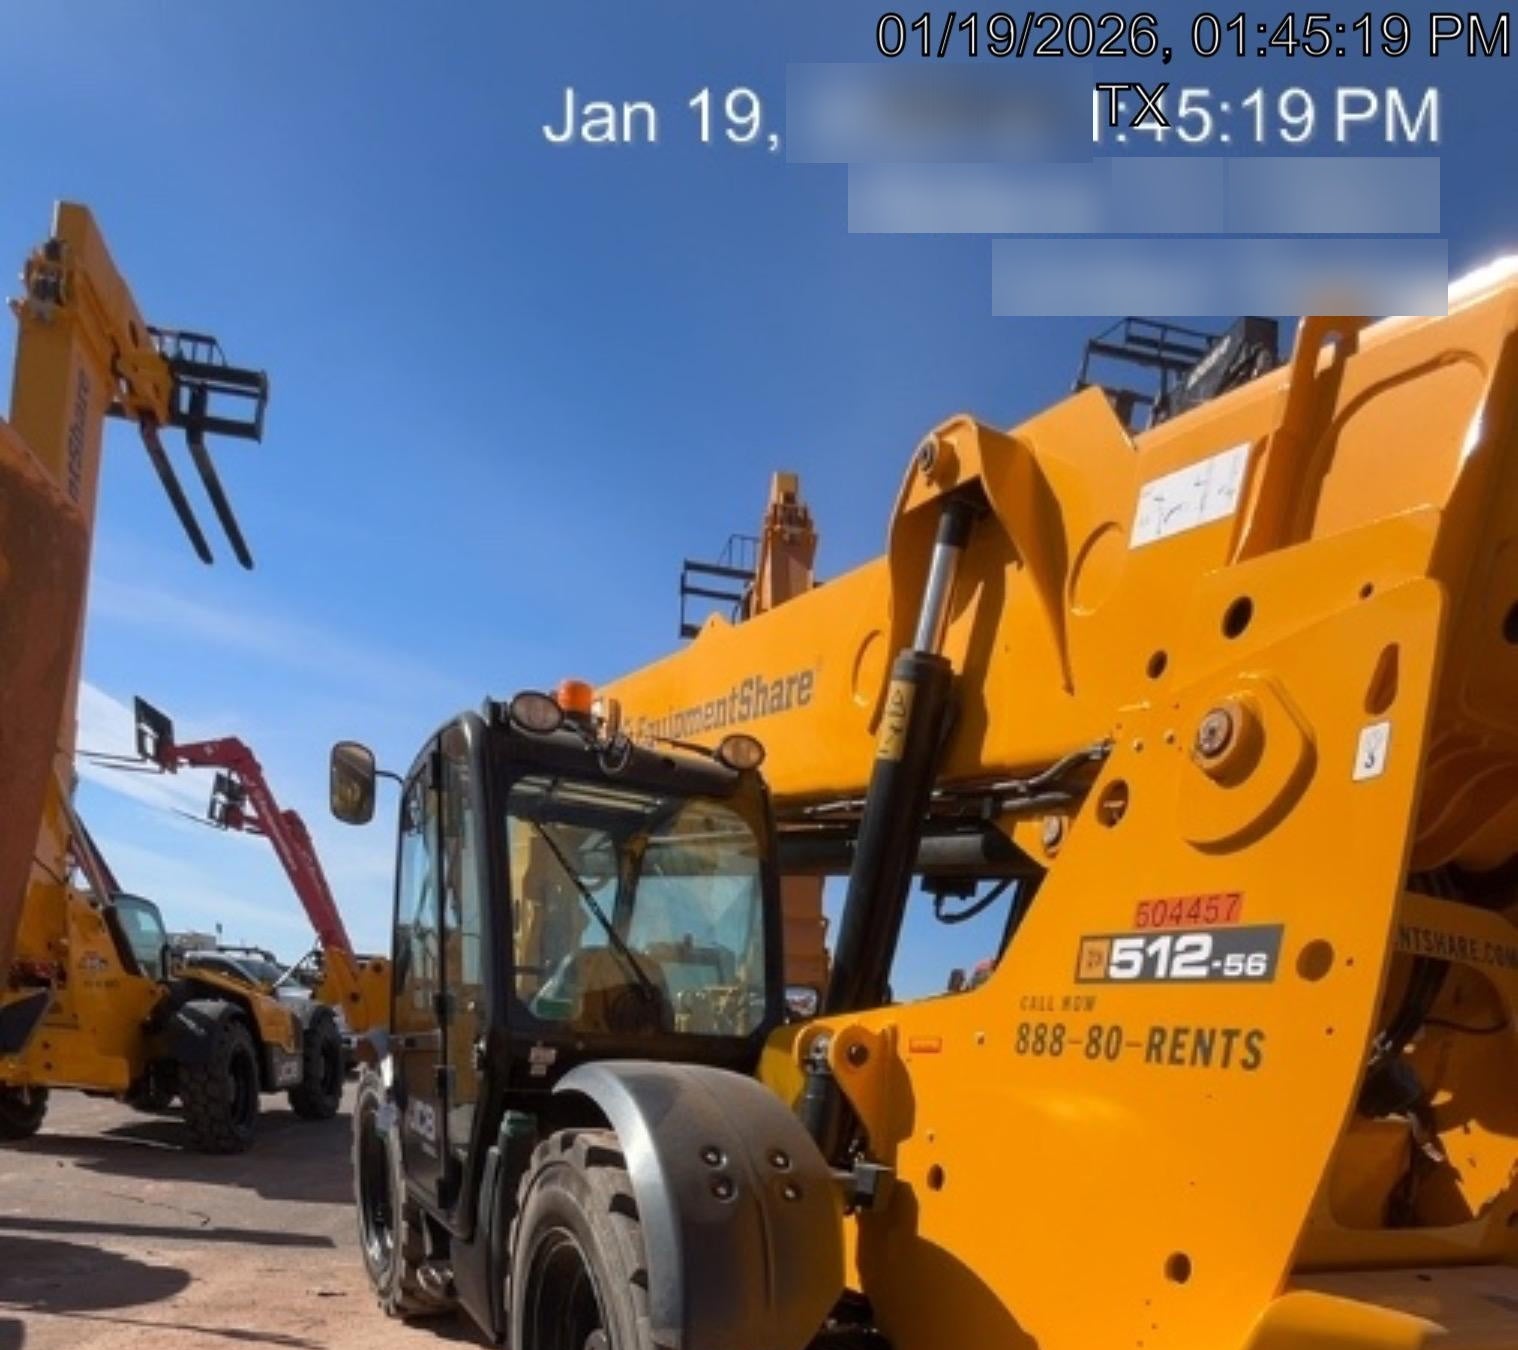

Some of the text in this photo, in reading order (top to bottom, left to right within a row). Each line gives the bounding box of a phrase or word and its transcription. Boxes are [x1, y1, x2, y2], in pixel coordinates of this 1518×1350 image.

[637, 669, 815, 745] EquipmentShare
[1136, 892, 1242, 928] 504457
[1108, 932, 1268, 980] 512-56
[1019, 995, 1097, 1012] CALL NOW
[1015, 1020, 1267, 1072] 888-80-RENTS
